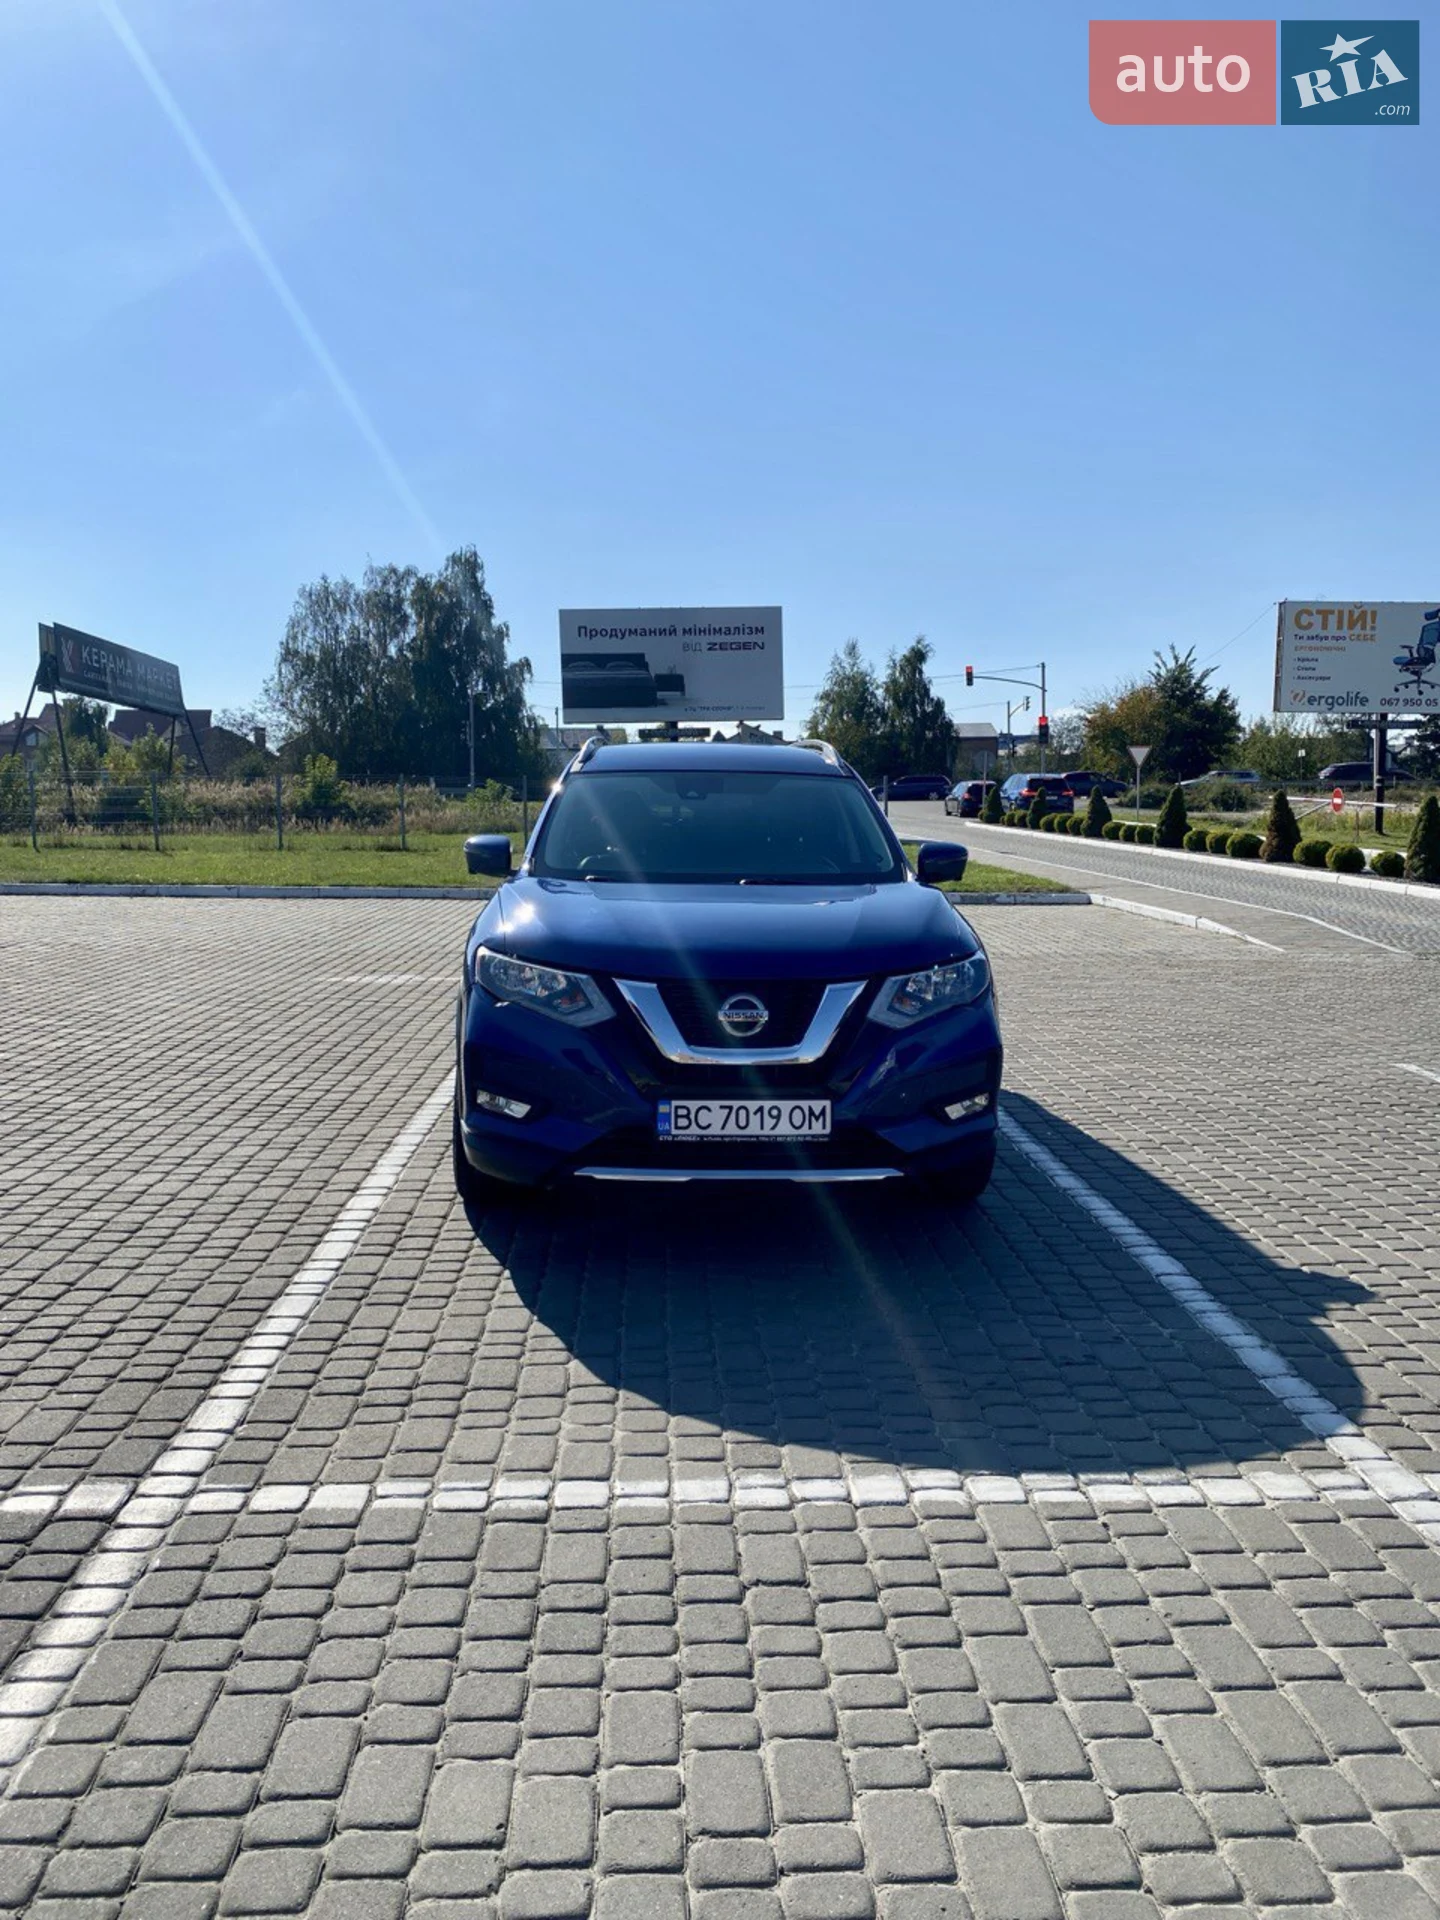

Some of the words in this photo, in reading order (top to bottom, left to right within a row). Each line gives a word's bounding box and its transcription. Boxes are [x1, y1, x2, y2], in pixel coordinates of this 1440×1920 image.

[1293, 604, 1378, 631] СТІЙ!
[577, 625, 677, 640] Продуманий
[682, 624, 765, 637] мінімалізм
[1349, 633, 1377, 642] СЕБЕ
[706, 641, 765, 652] ZEGEN
[1308, 691, 1369, 711] ergolife
[1380, 698, 1400, 707] 067
[1402, 698, 1422, 707] 950
[1424, 698, 1438, 707] 05
[658, 1123, 670, 1131] UA
